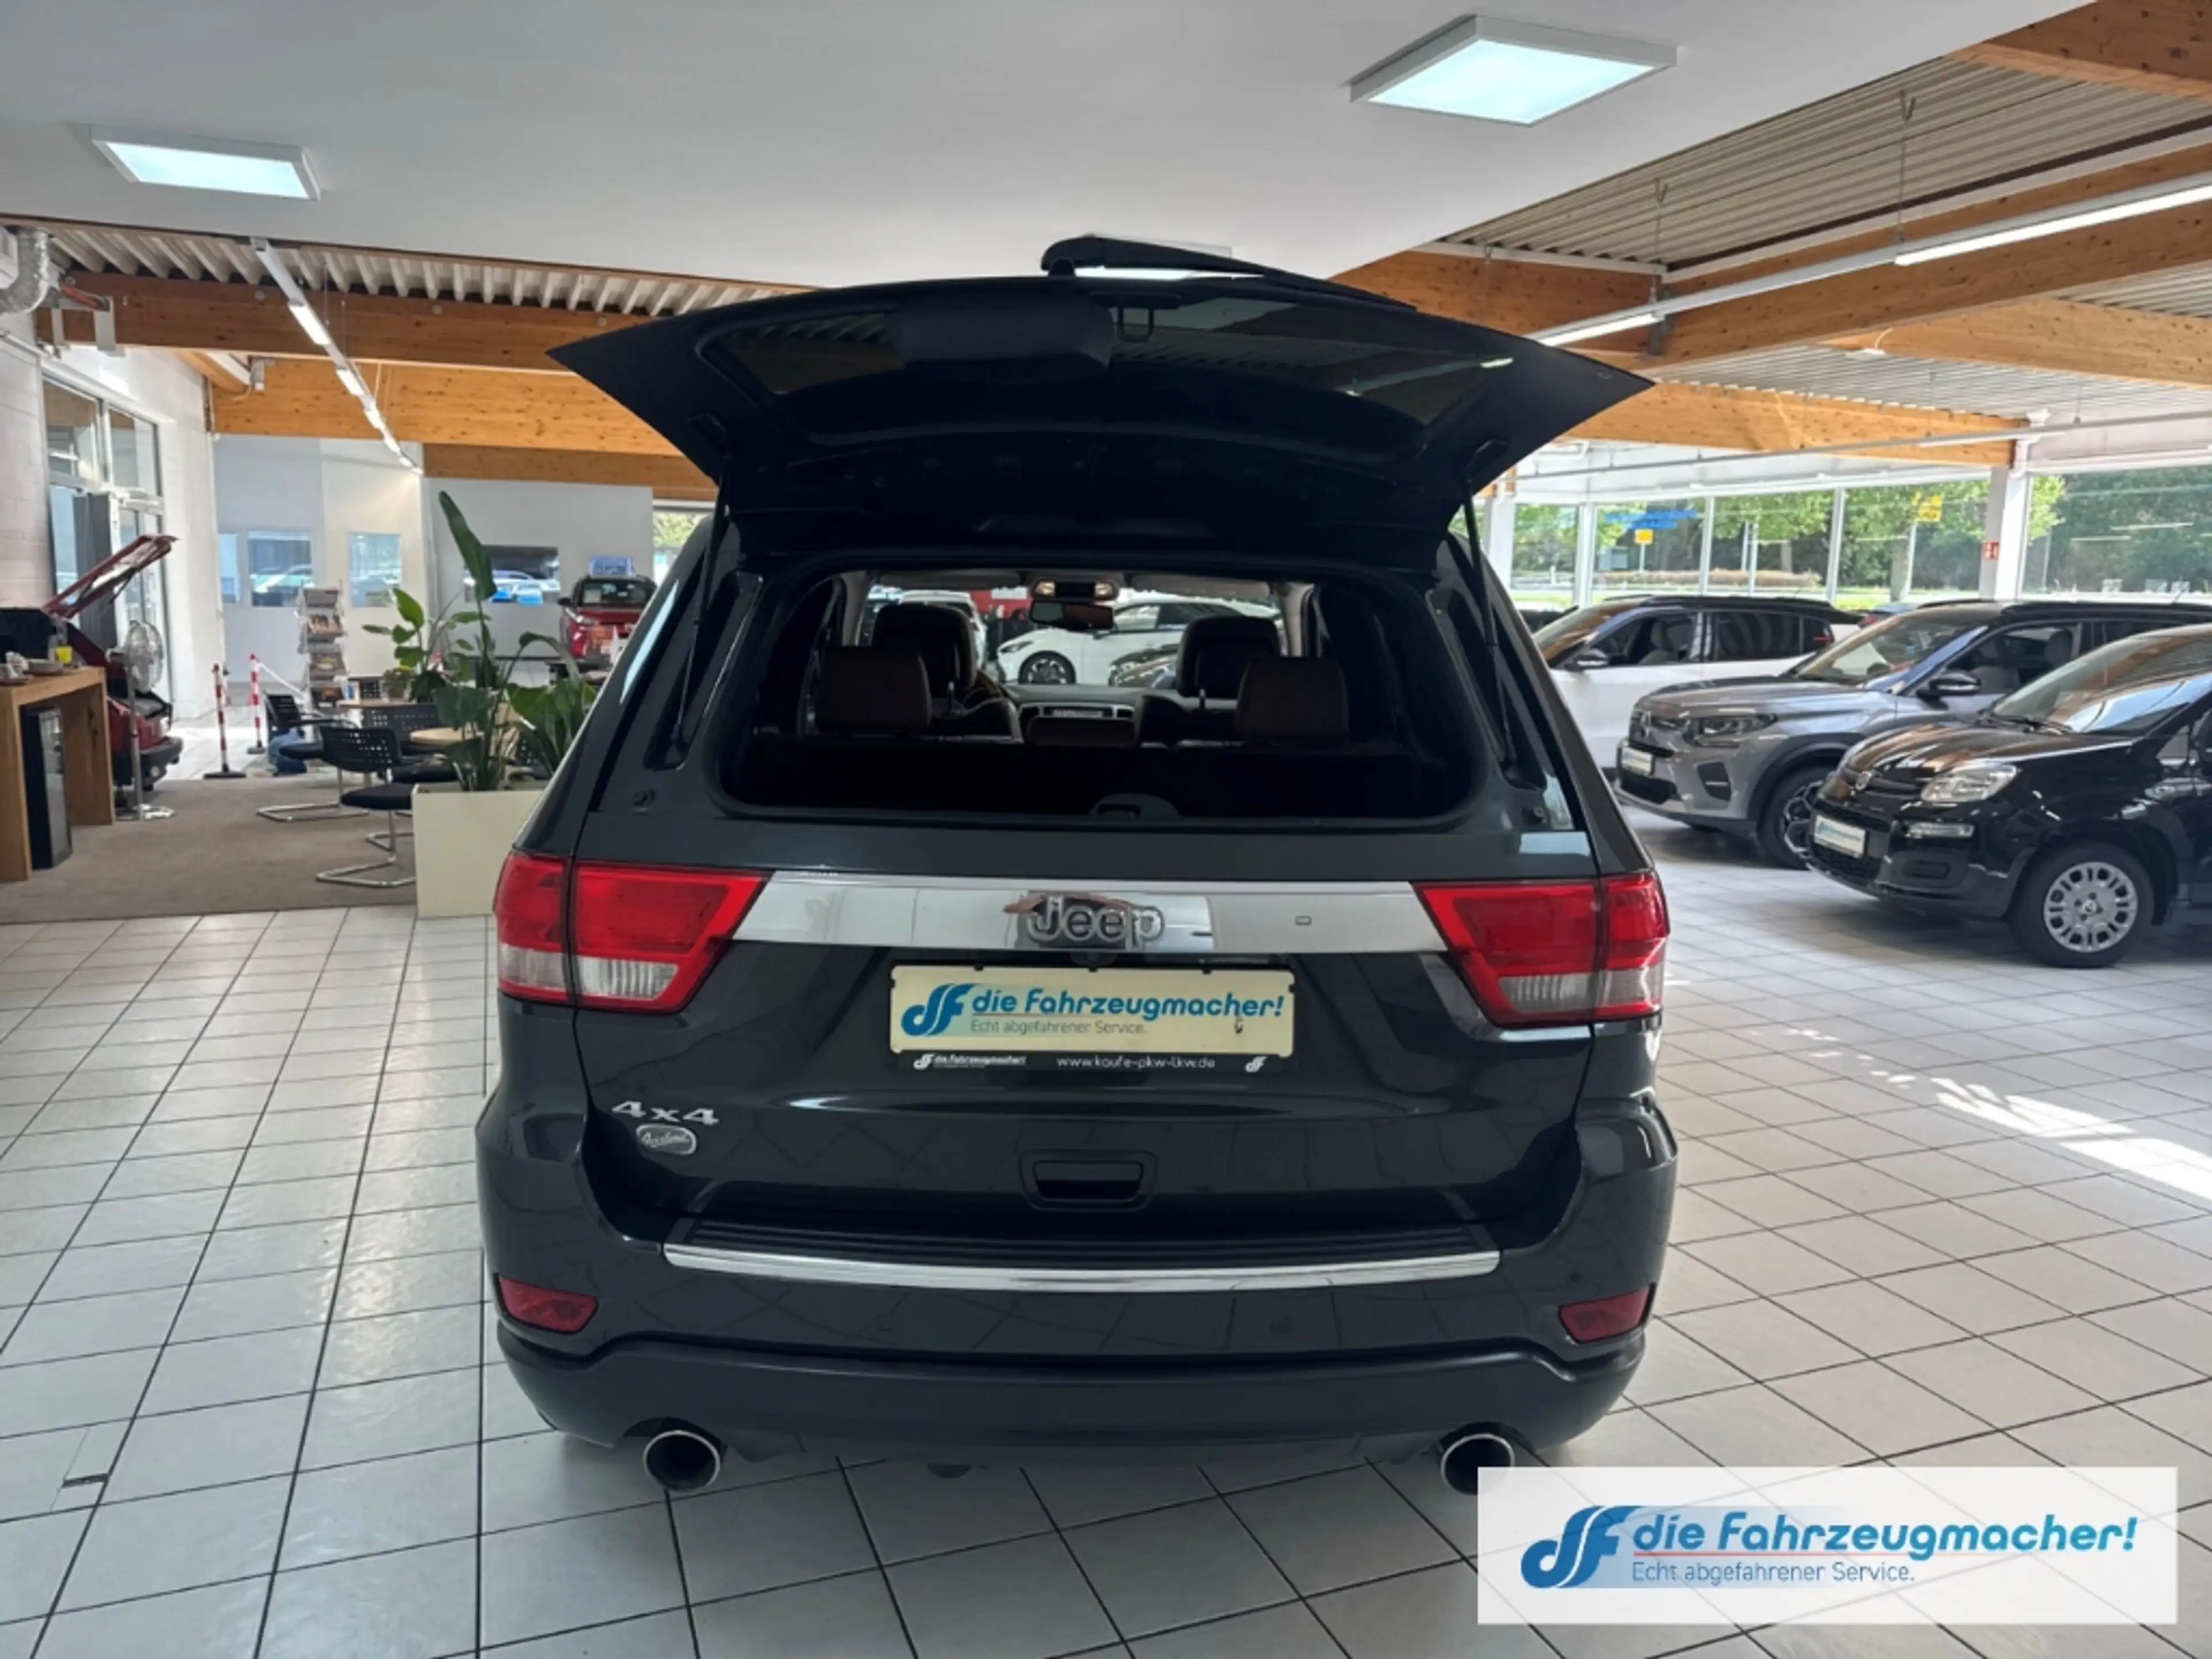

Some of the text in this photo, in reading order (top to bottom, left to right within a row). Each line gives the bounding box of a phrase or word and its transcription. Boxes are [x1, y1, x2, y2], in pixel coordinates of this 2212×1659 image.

[1027, 894, 1164, 950] Jeep
[972, 987, 1284, 1022] die Fahrzeugmacher!
[971, 1019, 1146, 1035] Echt abgefahrener Service.
[612, 1101, 719, 1126] 4x4
